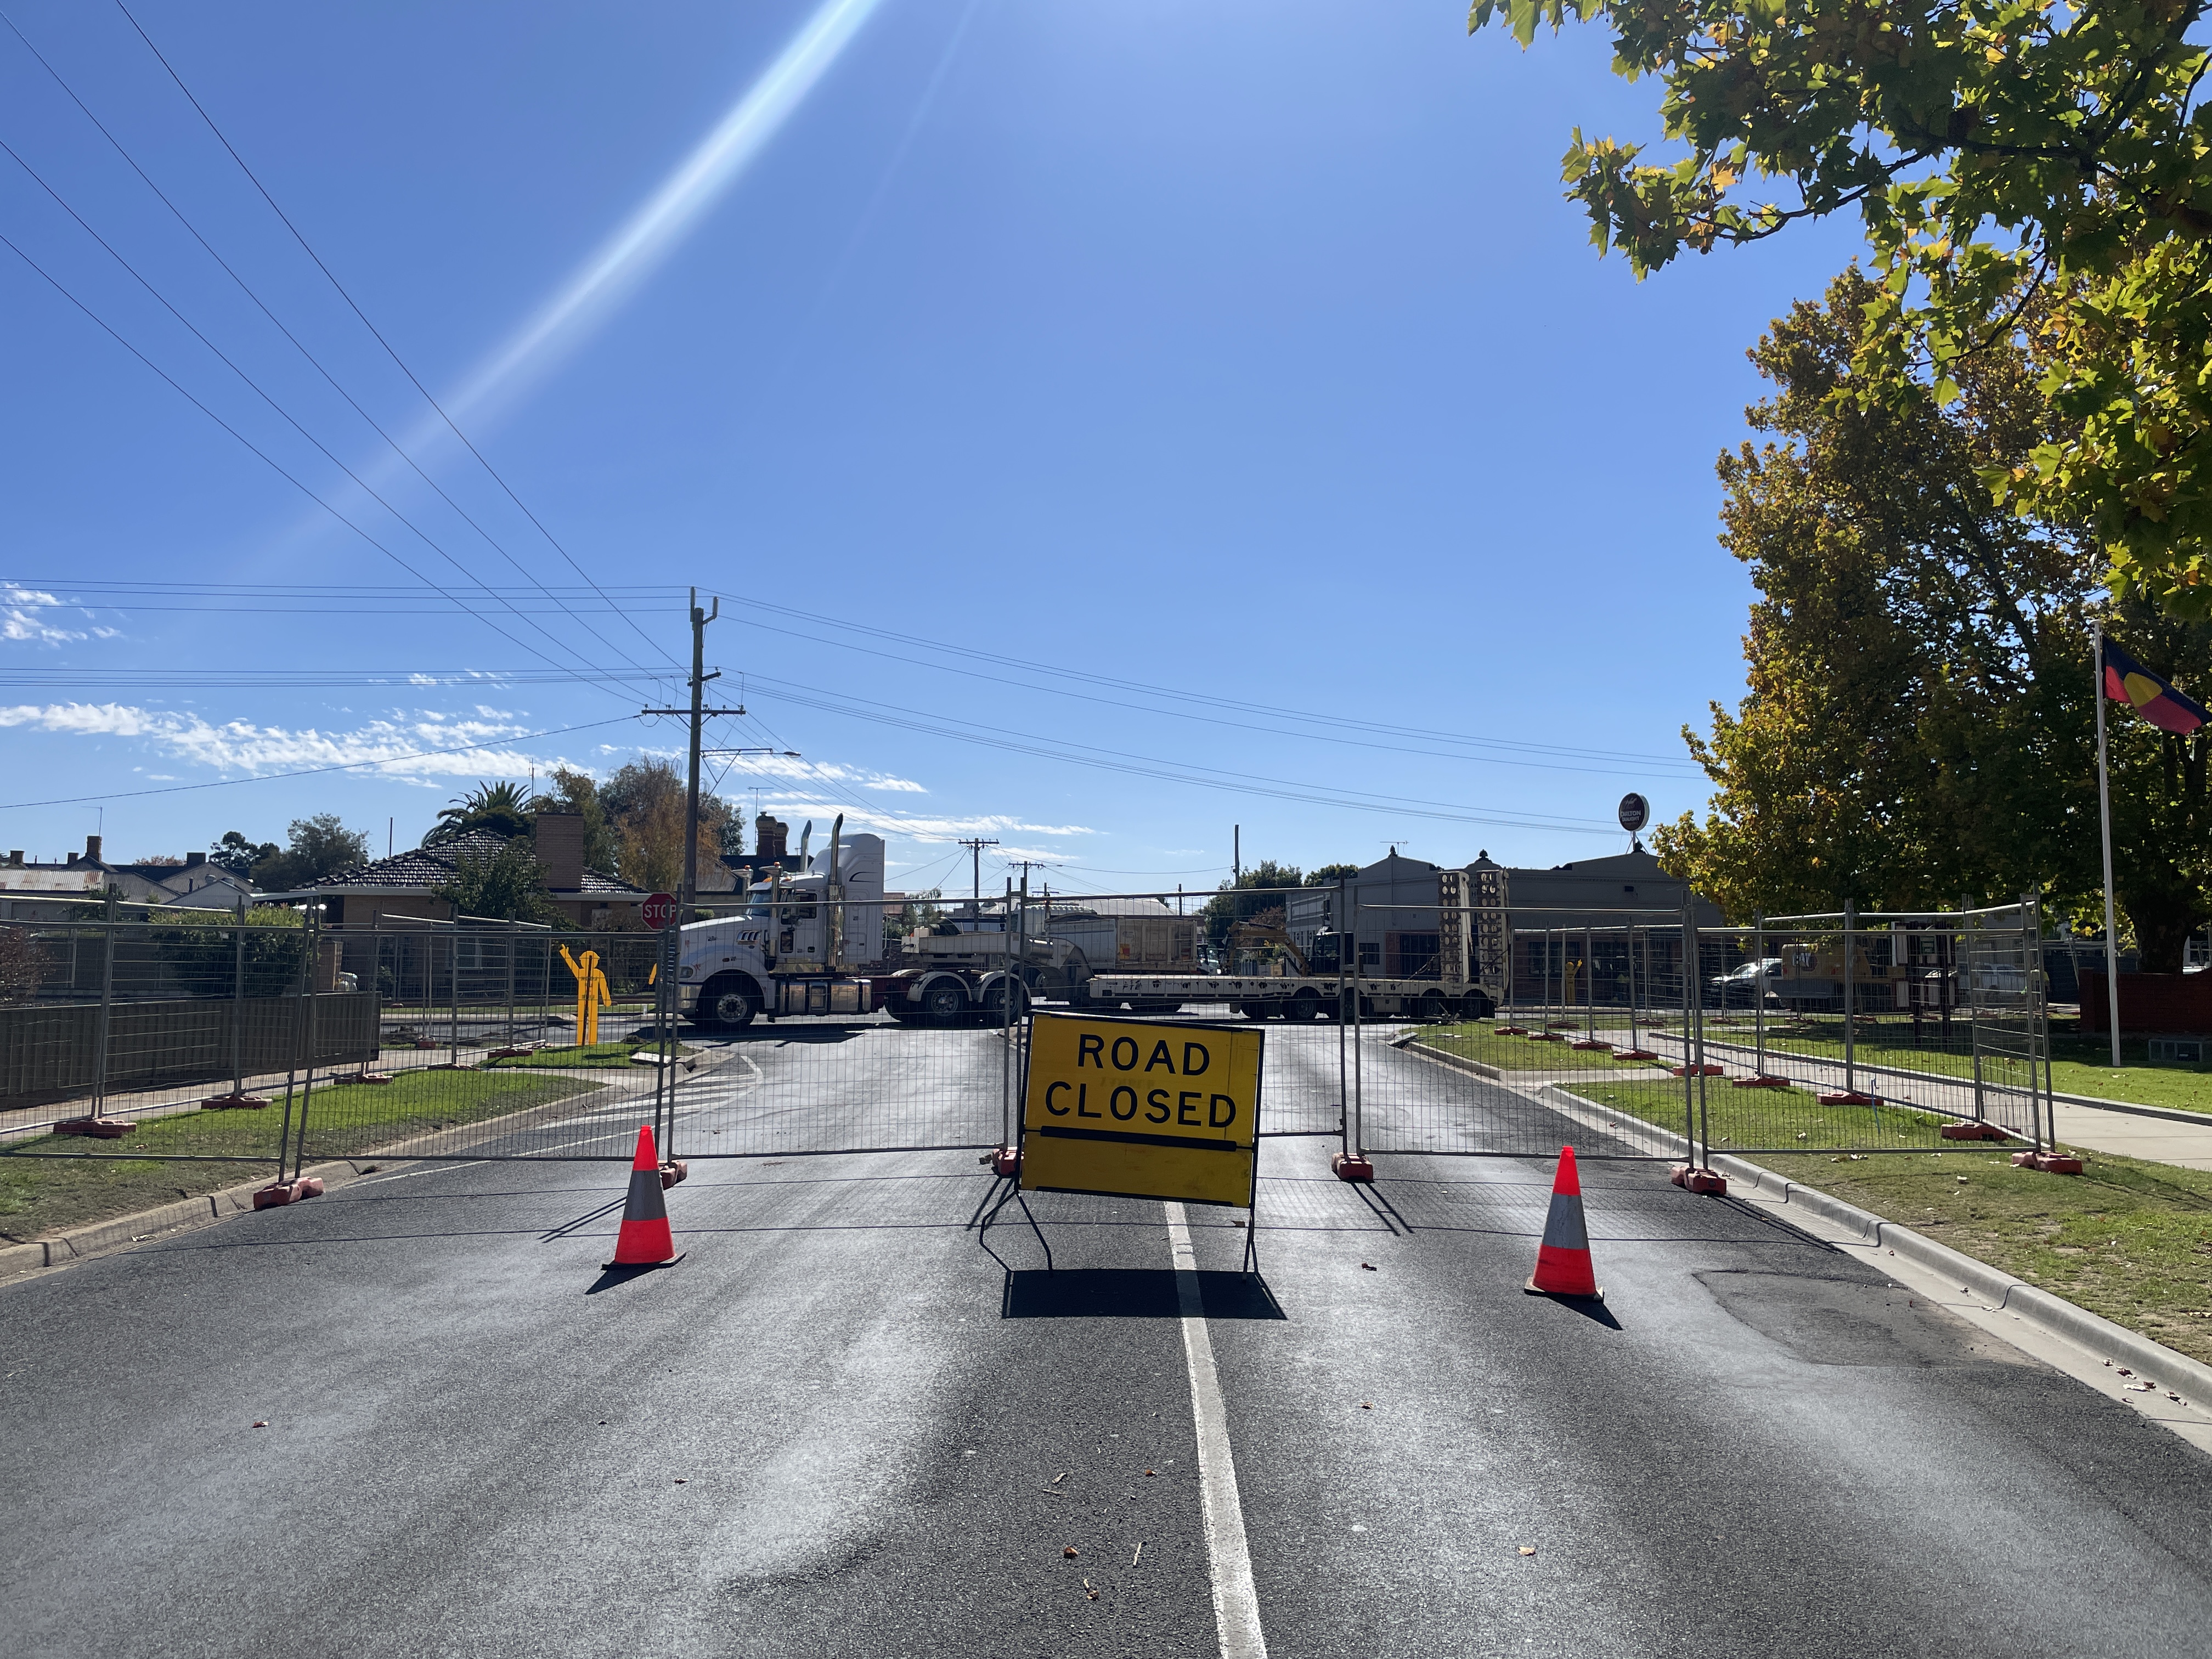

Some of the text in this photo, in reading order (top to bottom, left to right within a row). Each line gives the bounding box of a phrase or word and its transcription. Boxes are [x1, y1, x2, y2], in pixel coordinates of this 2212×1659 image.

[644, 904, 676, 918] STOP
[1077, 1034, 1210, 1076] ROAD
[1046, 1081, 1237, 1128] CLOSED
